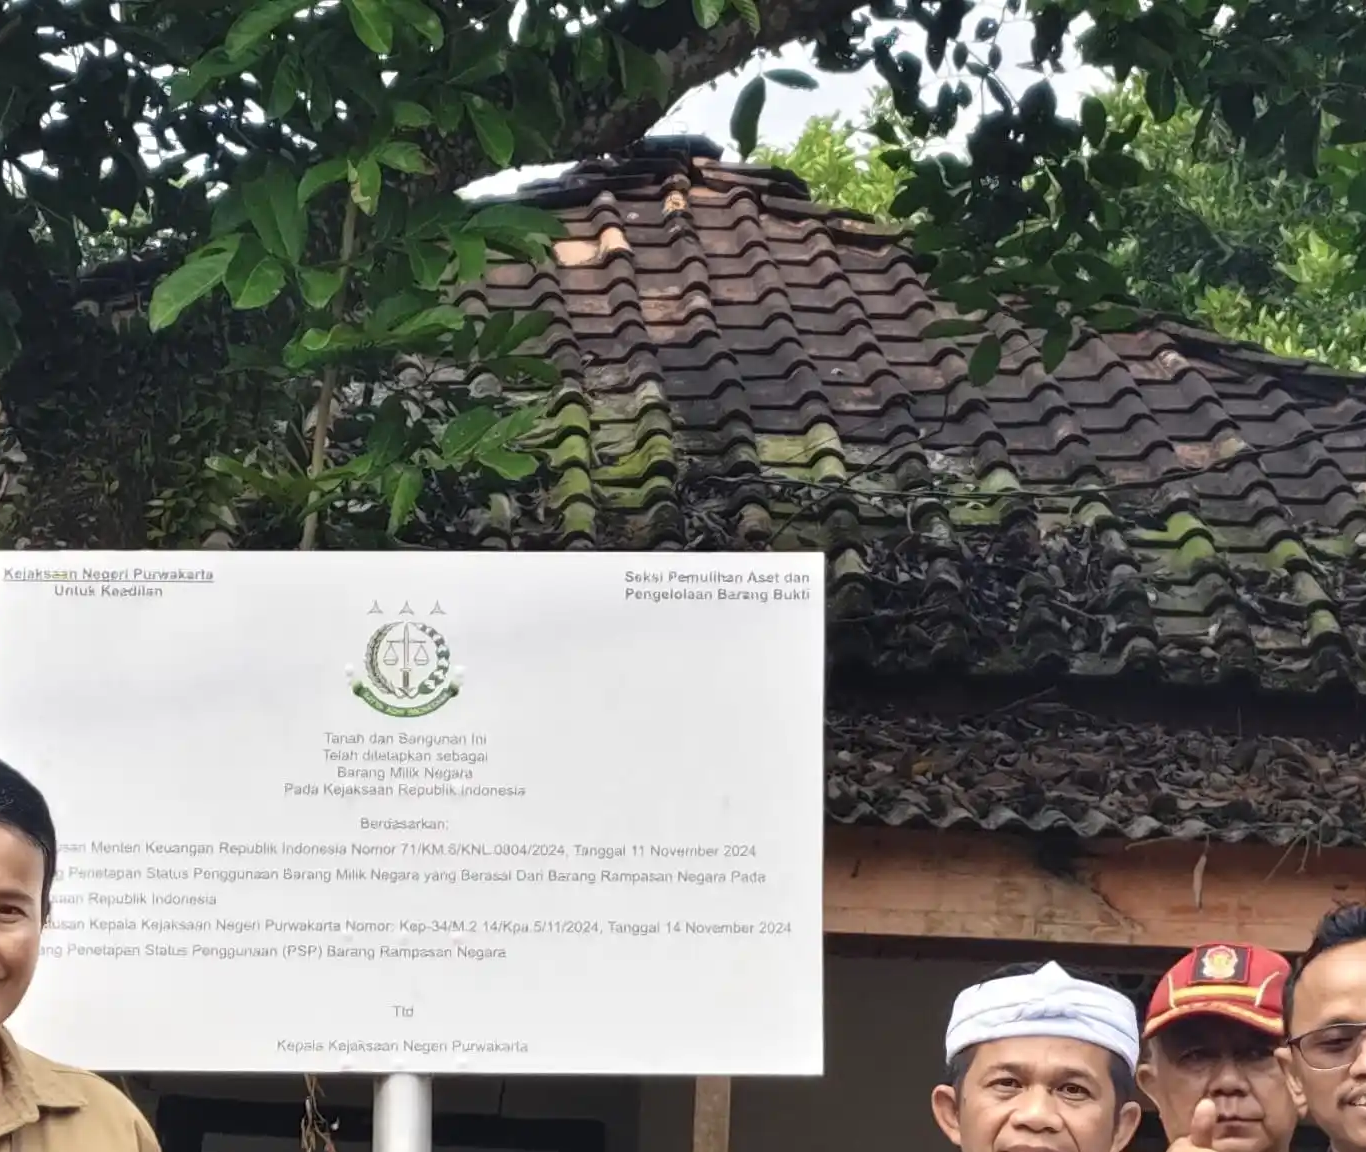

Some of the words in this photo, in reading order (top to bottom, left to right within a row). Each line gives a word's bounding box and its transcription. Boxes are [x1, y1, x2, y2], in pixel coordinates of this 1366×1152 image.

[3, 567, 79, 583] Kejaksaan
[81, 567, 130, 583] Negeri
[133, 567, 215, 584] Purwakarta
[624, 570, 664, 584] Seksi
[668, 570, 744, 585] Pemulihan
[746, 570, 780, 584] Aset
[783, 572, 810, 584] dan
[54, 584, 96, 597] Untuk
[100, 584, 163, 598] Keadilan
[625, 587, 713, 604] Pengelolaan
[717, 587, 769, 604] Barang
[773, 588, 810, 601] Bukti
[323, 731, 365, 745] Tanah
[368, 732, 395, 746] dan
[397, 731, 467, 748] Bangunan
[471, 732, 487, 747] Ini
[322, 748, 360, 762] Telah
[361, 749, 432, 766] ditetapkan
[435, 749, 488, 765] sebagai
[337, 765, 386, 782] Barang
[389, 766, 420, 780] Milik
[423, 766, 474, 782] Negara
[283, 782, 319, 796] Pada
[323, 782, 394, 799] Kejaksaan
[397, 782, 458, 799] Republik
[460, 783, 527, 798] Indonesia
[90, 840, 141, 855] Menteri
[145, 841, 214, 857] Keuangan
[218, 841, 278, 857] Republik
[281, 841, 348, 857] Indonesia
[351, 842, 398, 857] Nomor
[573, 843, 626, 860] Tanggal
[631, 844, 647, 858] 11
[650, 844, 720, 859] November
[722, 844, 757, 859] 2024
[68, 865, 143, 882] Penetapan
[146, 866, 190, 881] Status
[193, 867, 279, 884] Penggunaan
[282, 867, 332, 884] Barang
[335, 867, 367, 881] Milik
[369, 867, 420, 884] Negara
[423, 870, 457, 885] yang
[460, 868, 512, 882] Berasal
[515, 868, 544, 882] Dari
[547, 869, 597, 885] Barang
[600, 869, 674, 886] Rampasan
[677, 869, 727, 886] Negara
[730, 869, 767, 885] Pada
[87, 891, 148, 908] Republik
[151, 891, 217, 906] Indonesia
[89, 918, 137, 936] Kepala
[140, 918, 212, 935] Kejaksaan
[215, 918, 261, 935] Negeri
[264, 918, 342, 933] Purwakarta
[607, 920, 660, 937] Tanggal
[666, 920, 682, 934] 14
[685, 921, 755, 935] November
[758, 921, 794, 935] 2024
[66, 943, 141, 961] Penetapan
[144, 943, 188, 957] Status
[191, 943, 279, 961] Penggunaan
[282, 943, 323, 960] (PSP)
[326, 944, 376, 961] Barang
[379, 944, 453, 961] Rampasan
[456, 945, 508, 962] Negara
[391, 1004, 414, 1018] Ttd
[276, 1039, 325, 1055] Kepala
[328, 1039, 399, 1055] Kejaksaan
[403, 1039, 448, 1055] Negeri
[451, 1039, 529, 1053] Purwakarta
